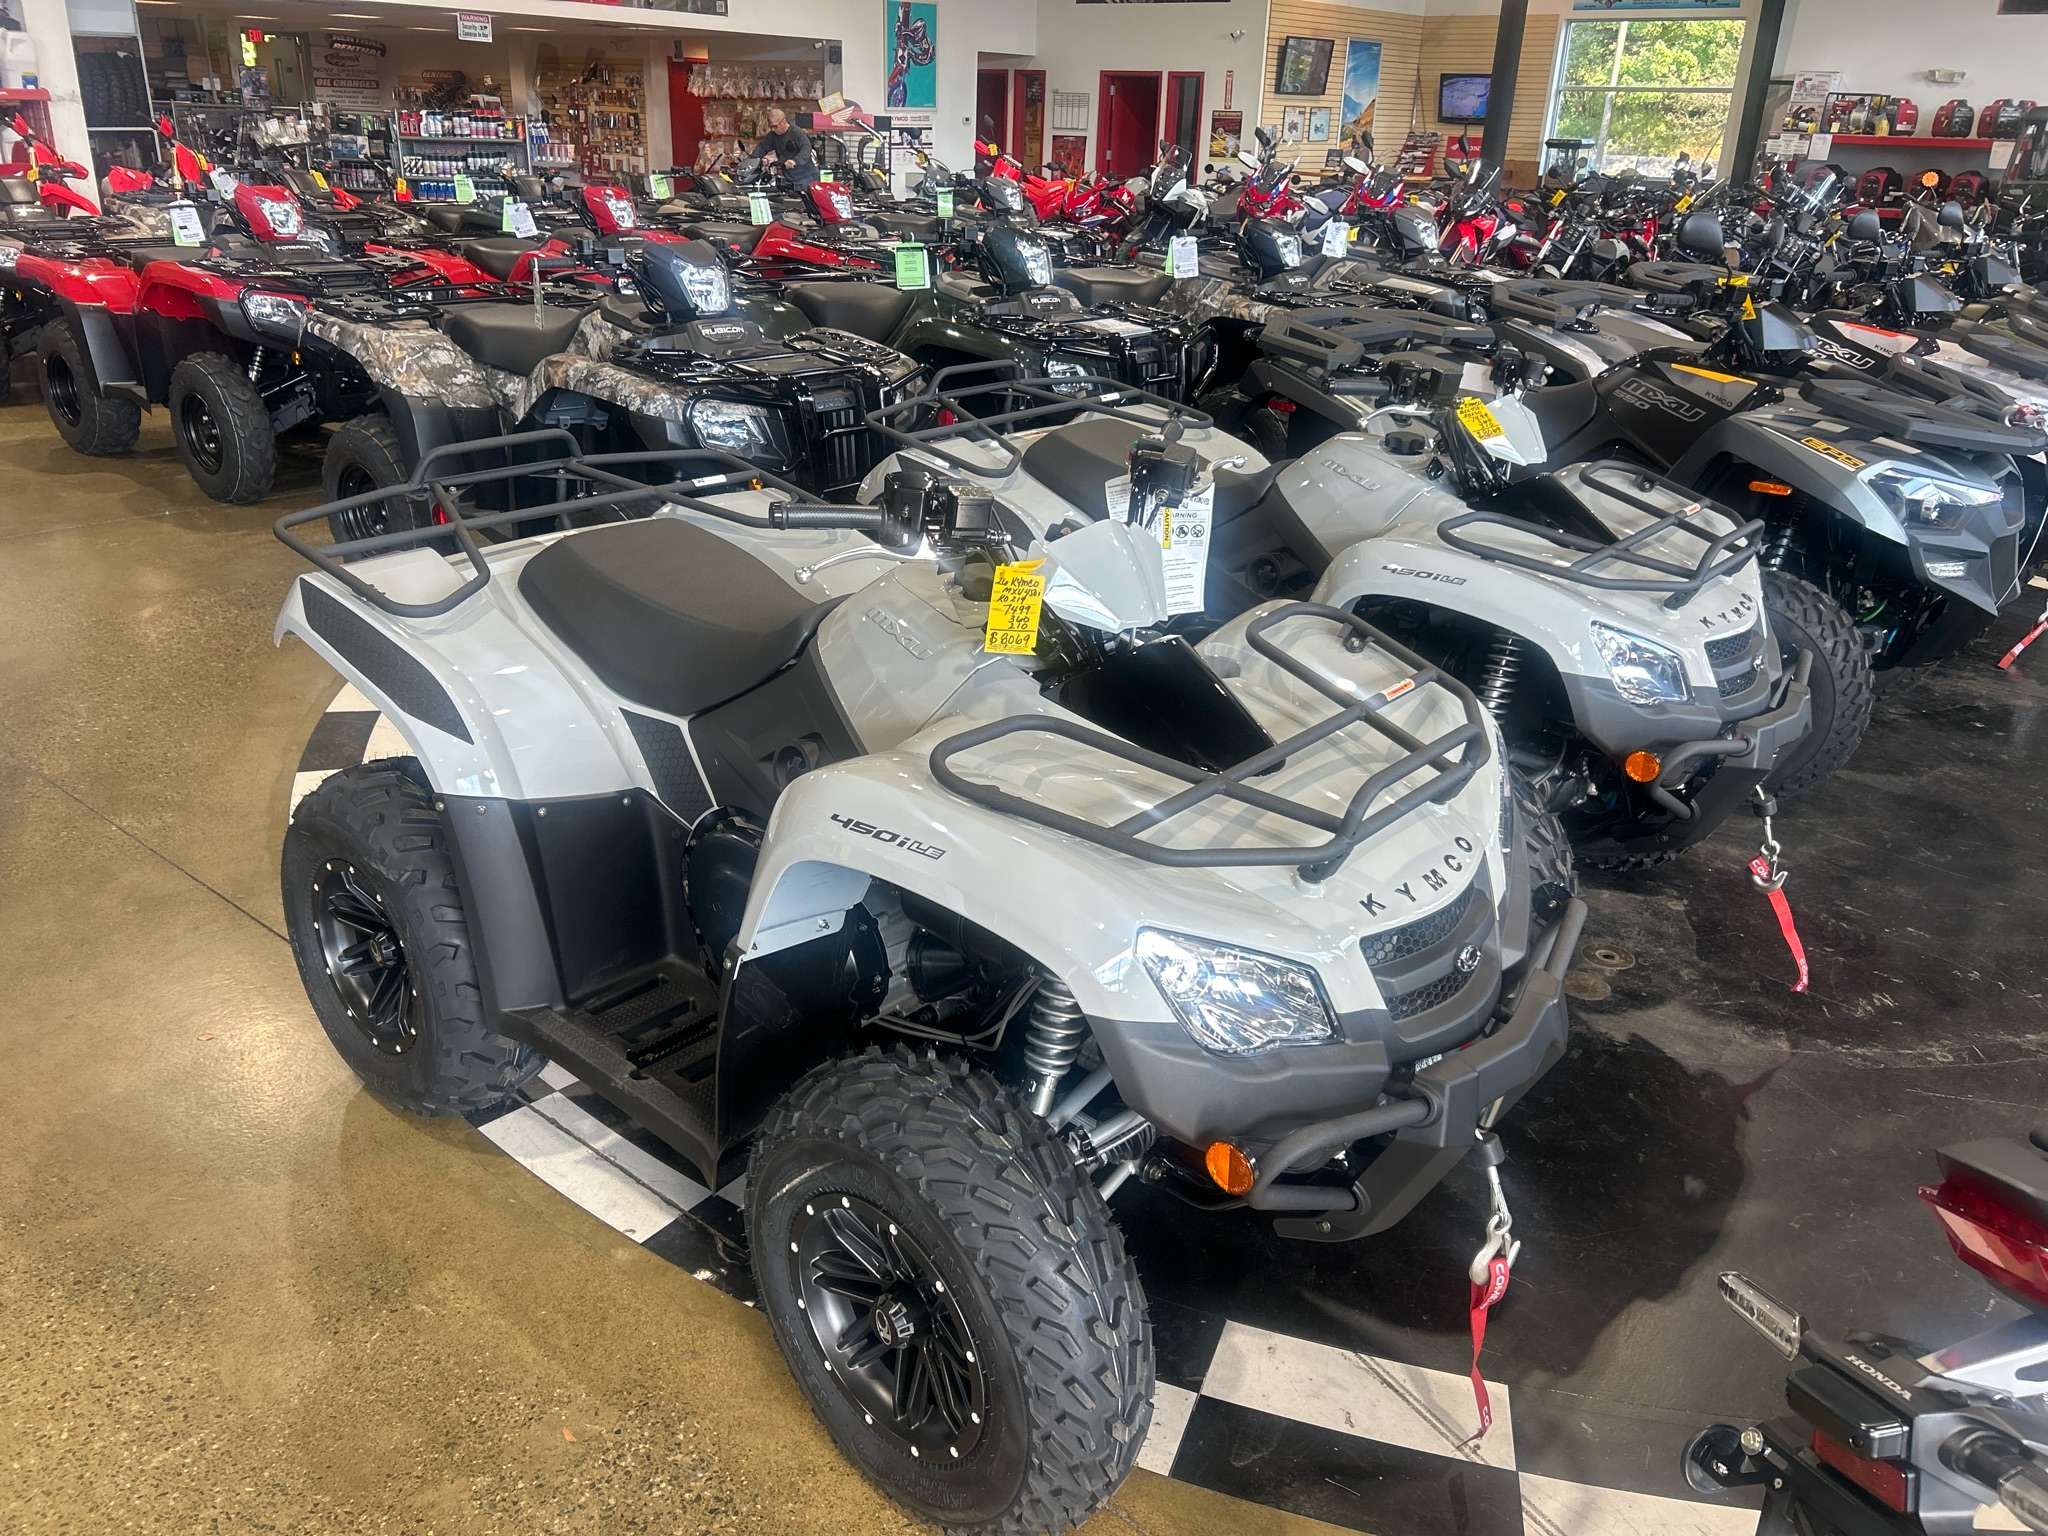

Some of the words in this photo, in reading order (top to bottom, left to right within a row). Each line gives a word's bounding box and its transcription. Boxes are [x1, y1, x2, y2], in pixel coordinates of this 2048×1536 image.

[461, 14, 488, 22] WARNING
[462, 23, 477, 31] Security
[250, 30, 262, 42] EXIT
[333, 43, 383, 57] RENTHAL
[316, 78, 331, 86] OIL
[333, 79, 377, 88] CHANGES
[702, 326, 745, 335] RUBICON
[1874, 344, 1894, 356] KYMC
[816, 397, 852, 409] ONDA
[1612, 389, 1651, 410] 550
[1620, 377, 1707, 422] MXU
[1704, 391, 1733, 408] KYMCO
[1801, 437, 1866, 469] EPS
[1003, 603, 1031, 615] 7499
[1699, 593, 1753, 629] KYMCO
[1008, 622, 1028, 630] 210
[866, 607, 933, 660] MXU
[1359, 836, 1473, 917] KYMCO
[1843, 1354, 1912, 1401] HONDA
